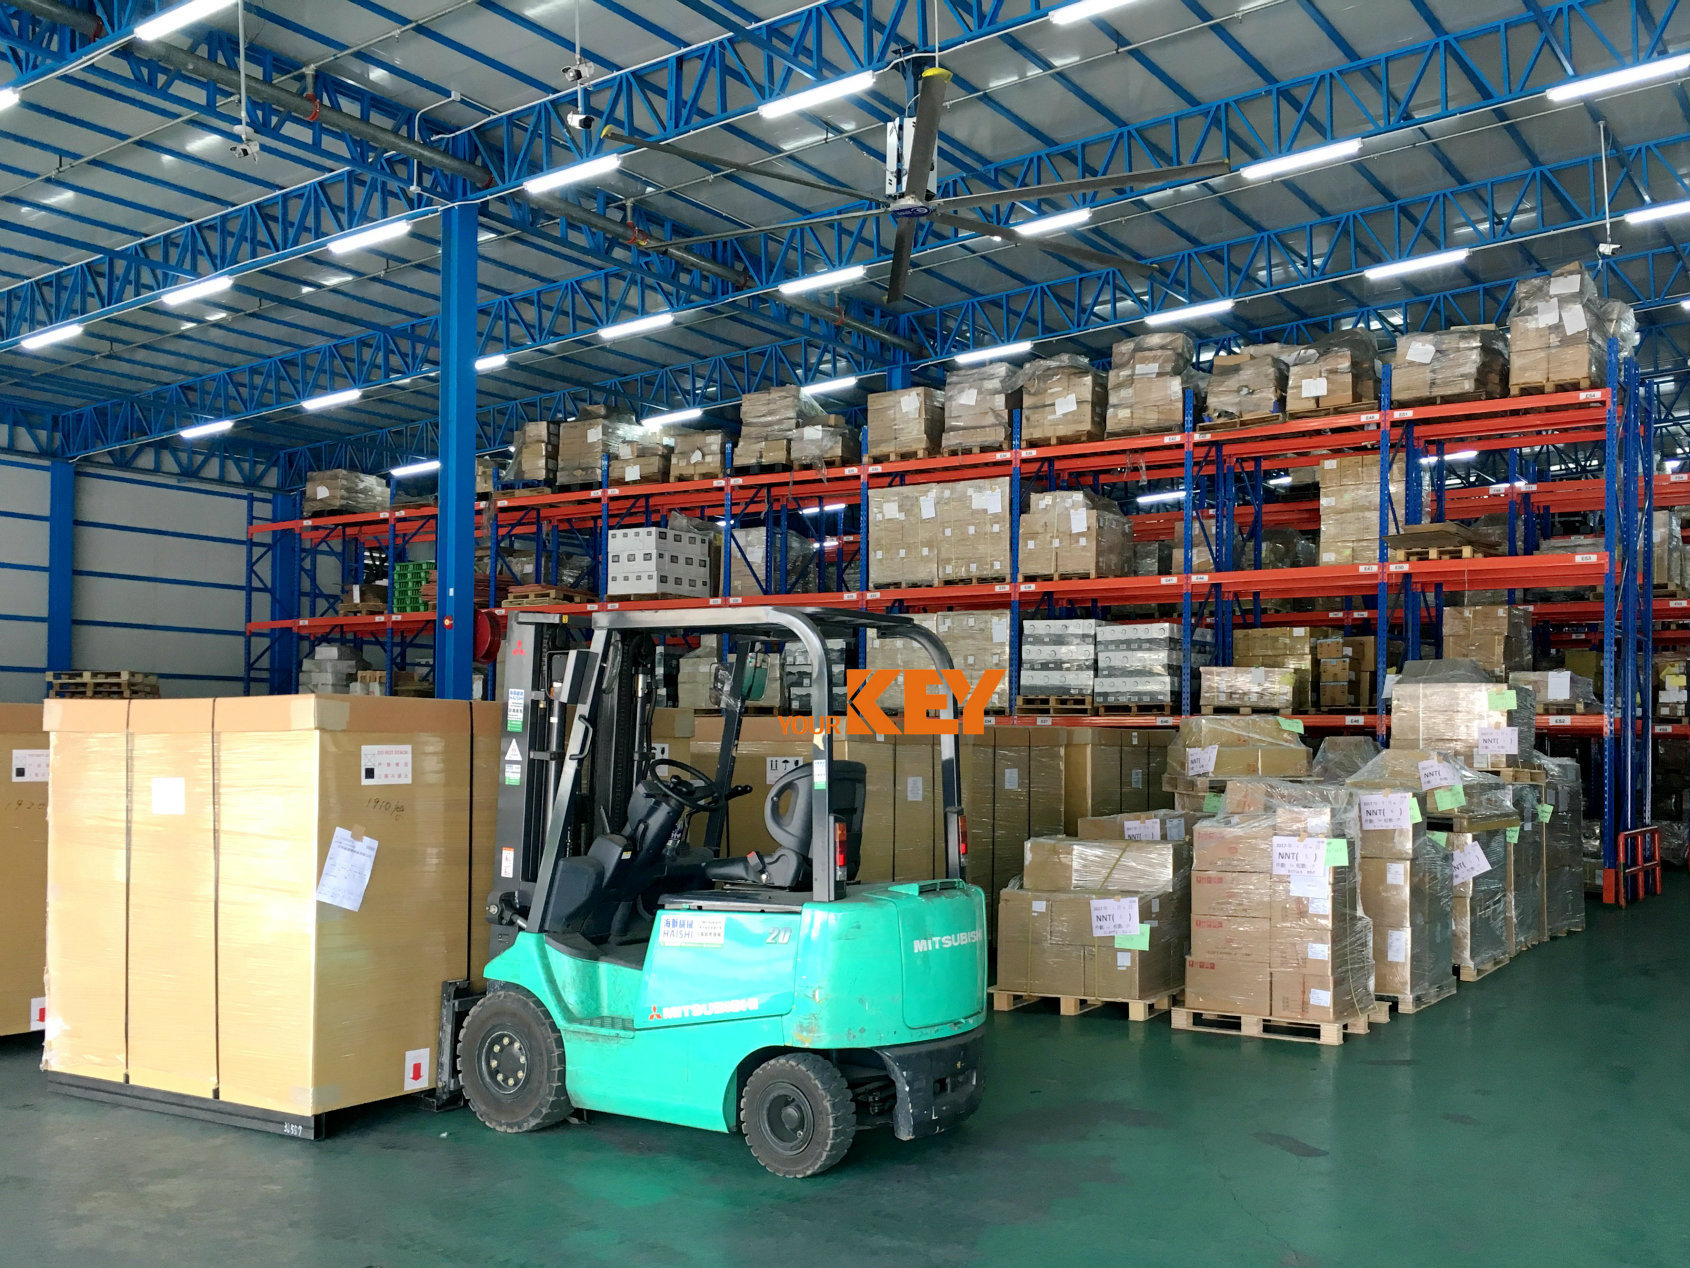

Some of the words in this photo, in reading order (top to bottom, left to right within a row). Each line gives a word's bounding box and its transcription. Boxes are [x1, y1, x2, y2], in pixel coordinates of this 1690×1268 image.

[663, 929, 693, 939] HAISHI
[766, 927, 792, 944] 20
[662, 997, 759, 1019] MITSUBISHI
